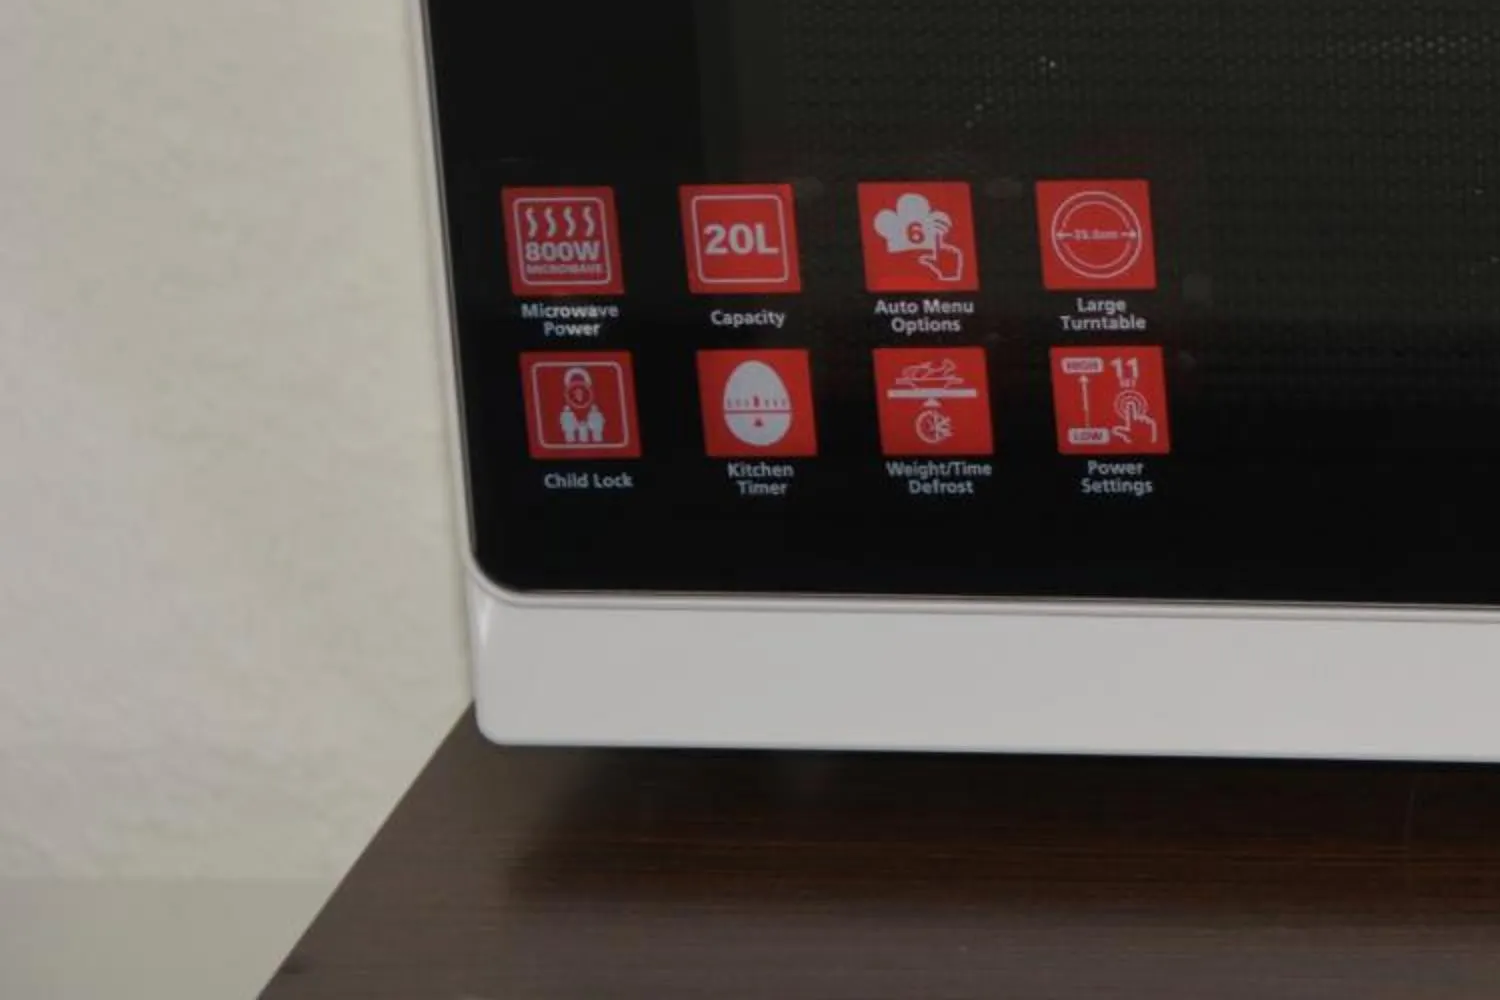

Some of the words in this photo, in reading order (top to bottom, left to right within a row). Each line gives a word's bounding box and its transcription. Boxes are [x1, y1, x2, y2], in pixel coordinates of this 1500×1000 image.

[704, 222, 779, 255] 20L
[906, 222, 926, 244] 6
[524, 240, 600, 263] 800W
[521, 303, 619, 319] Microwave
[874, 299, 919, 315] Auto
[924, 299, 975, 314] Menu
[1077, 297, 1127, 315] Large
[711, 309, 785, 328] Capacity
[891, 316, 961, 335] Options
[1059, 314, 1147, 331] Turntable
[544, 321, 601, 337] Power
[1110, 357, 1138, 379] 11
[727, 462, 794, 478] Kitchen
[886, 460, 993, 479] Weight/Time
[1087, 459, 1145, 476] Power
[544, 473, 588, 489] Child
[594, 472, 633, 489] Lock
[738, 480, 788, 496] Timer
[908, 478, 974, 496] Defrost
[1081, 477, 1153, 497] Settings
